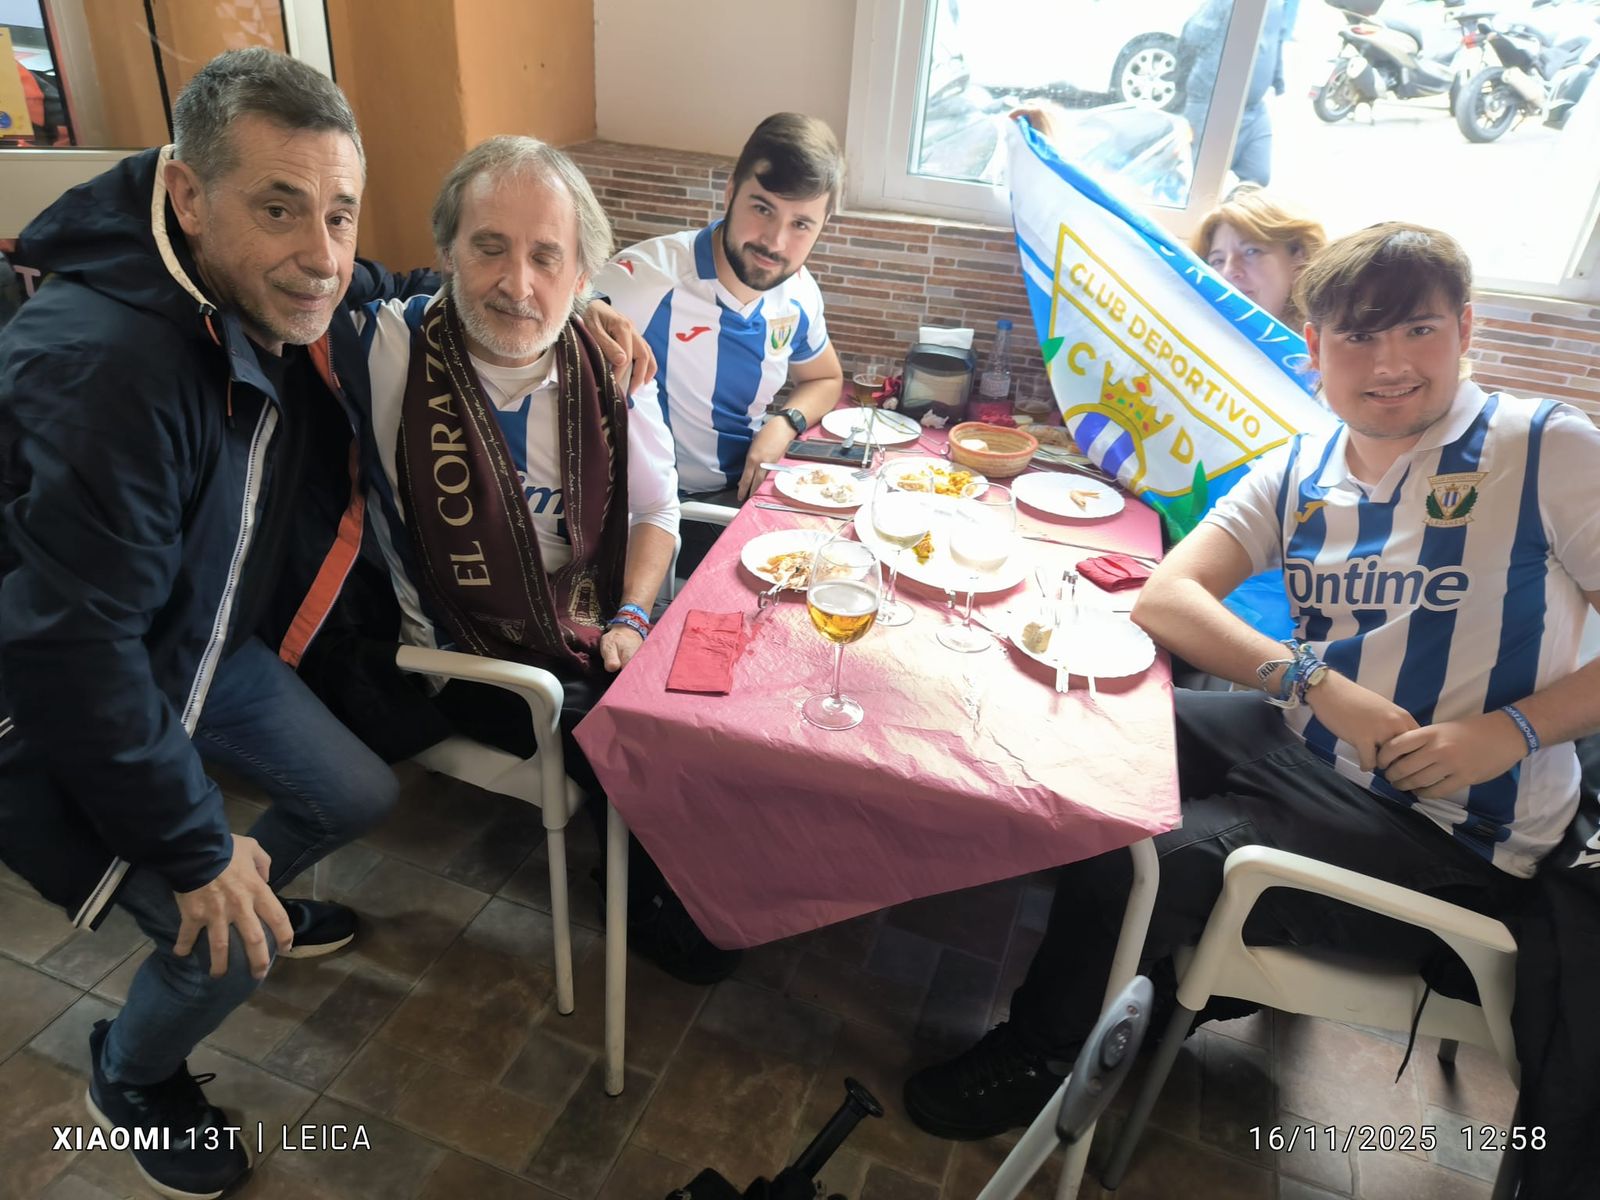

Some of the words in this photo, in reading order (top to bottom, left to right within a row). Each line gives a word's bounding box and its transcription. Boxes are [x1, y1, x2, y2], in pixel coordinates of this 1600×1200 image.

[1069, 262, 1128, 323] CLUB
[1127, 315, 1261, 439] DEPORTIVO
[1067, 342, 1096, 376] C
[1169, 426, 1195, 465] D
[450, 540, 492, 586] EL
[1285, 560, 1470, 607] Ontime
